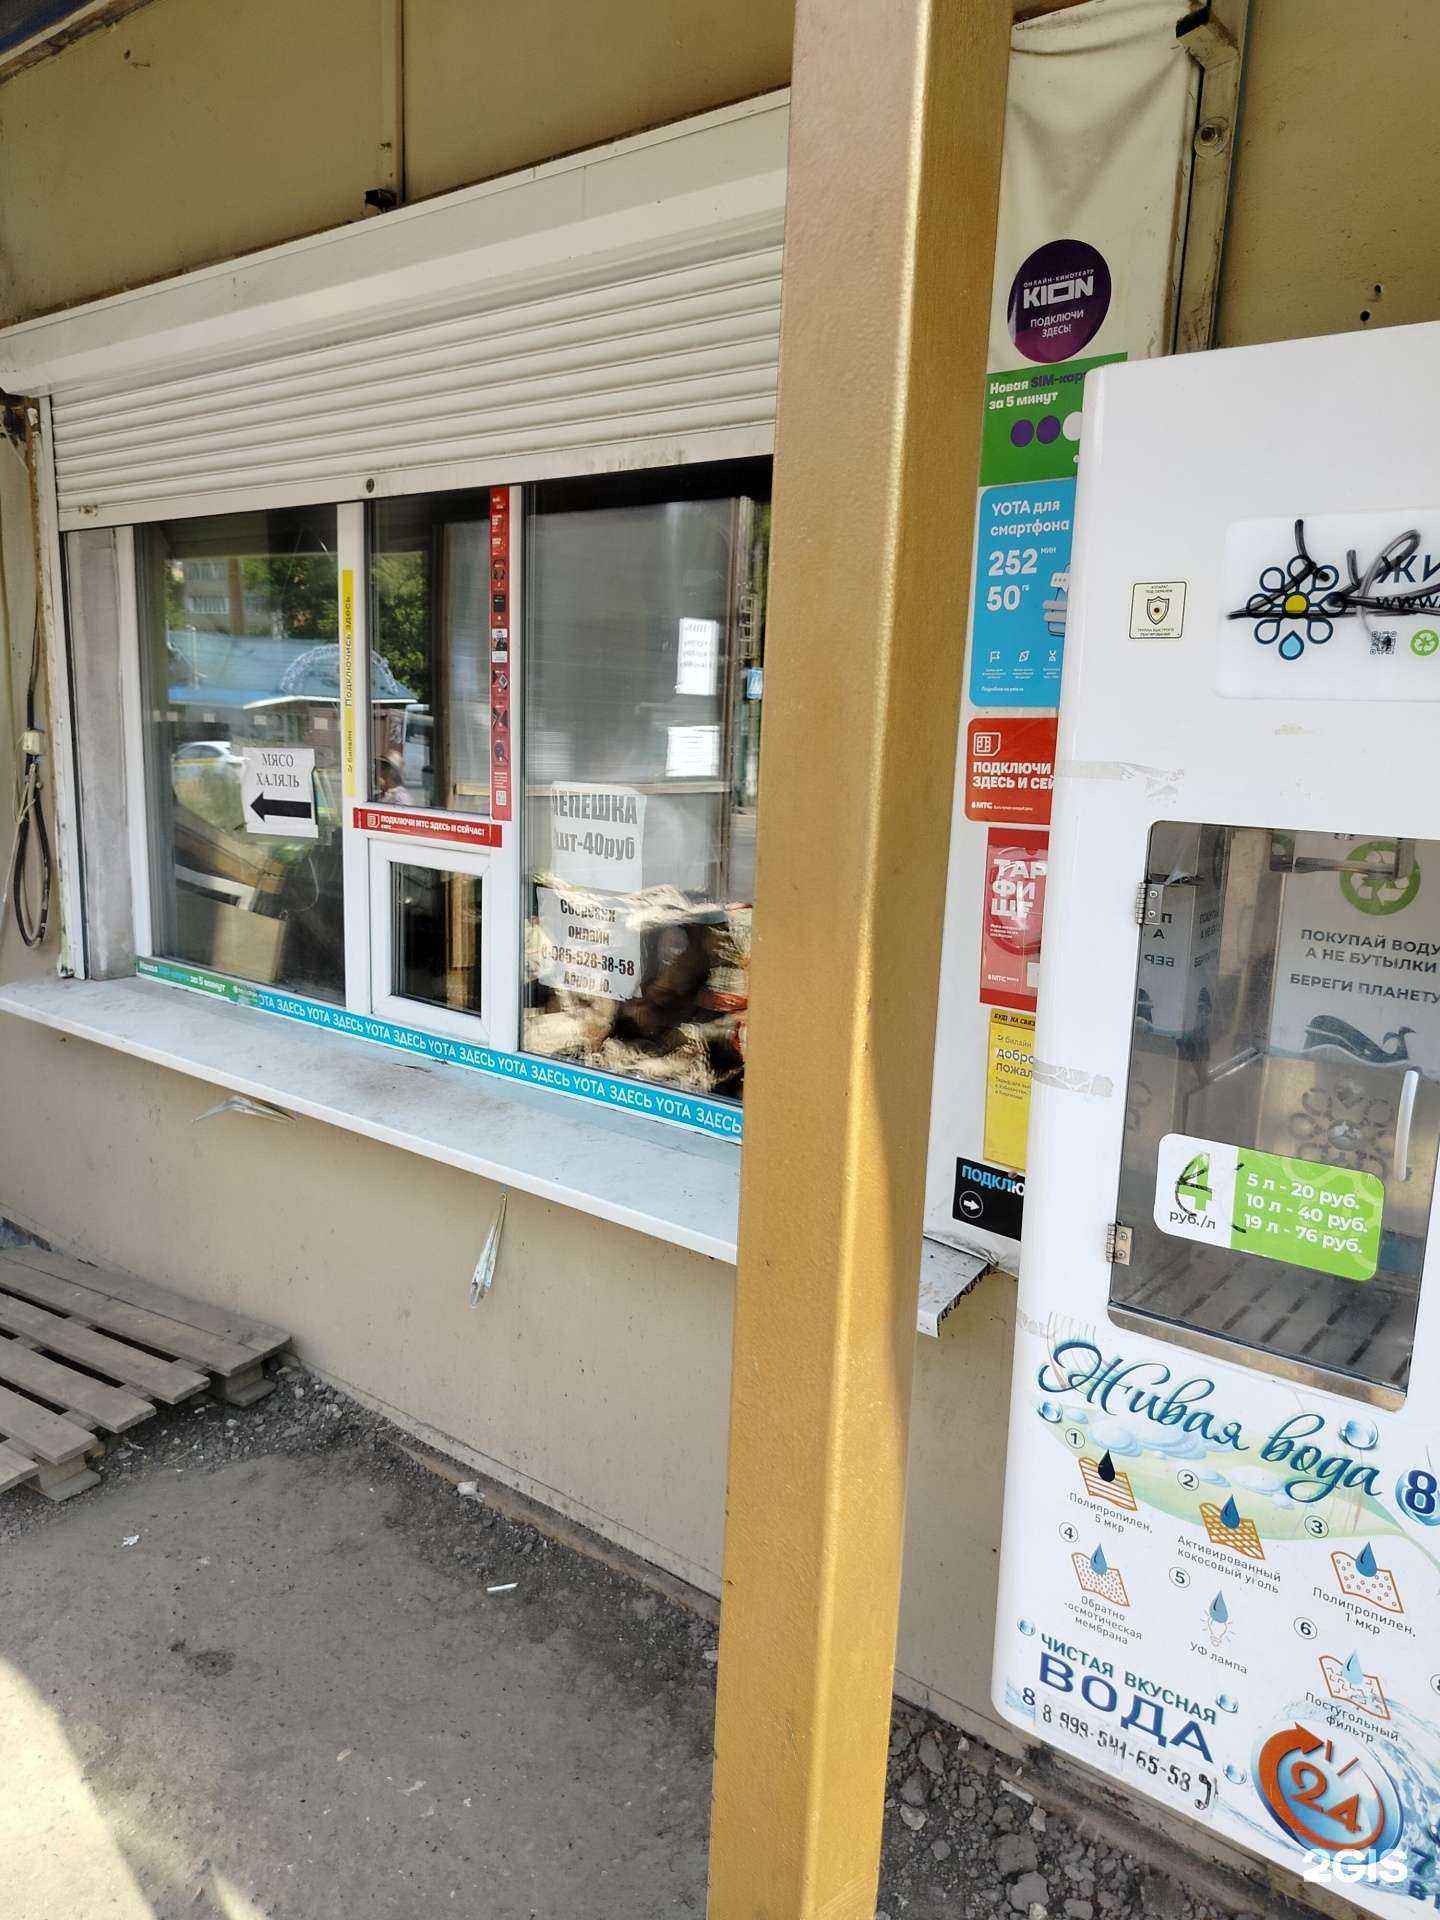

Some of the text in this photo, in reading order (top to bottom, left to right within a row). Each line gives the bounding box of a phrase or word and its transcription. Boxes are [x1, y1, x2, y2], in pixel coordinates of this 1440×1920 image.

[1023, 276, 1094, 309] KION
[1030, 309, 1084, 328] ПОДКЛЮЧИ
[1041, 324, 1072, 338] ЗДЕСЬ!
[990, 379, 1029, 394] Новая
[988, 391, 1058, 410] за 5 минут
[992, 500, 1060, 516] YOTA для
[991, 519, 1070, 538] смартфона
[988, 548, 1038, 577] 252
[986, 585, 1021, 612] 50
[262, 752, 294, 767] МЯСО
[973, 761, 1051, 775] ПОДКЛЮЧИ
[256, 772, 301, 788] ХАЛЯЛЬ
[973, 776, 1016, 789] ЗДЕСЬ
[1018, 777, 1028, 789] И
[381, 814, 415, 828] ПОДКЛЮЧИ
[1301, 929, 1386, 949] ПОКУПАЙ
[1305, 949, 1437, 973] А НЕ БУТЫЛКИ
[1290, 972, 1353, 992] БЕРЕГИ
[277, 998, 306, 1018] ЗДЕСЬ
[307, 1006, 331, 1024] YOTA
[333, 1013, 363, 1032] ЗДЕСЬ
[364, 1022, 391, 1040] YOTA
[394, 1030, 426, 1049] ЗДЕСЬ
[428, 1039, 456, 1057] YOTA
[459, 1047, 496, 1068] ЗДЕСЬ
[498, 1057, 527, 1077] YOTA
[531, 1065, 570, 1087] ЗДЕСЬ
[572, 1075, 606, 1097] YOTA
[610, 1085, 653, 1108] ЗДЕСЬ
[655, 1096, 691, 1120] YOTA
[696, 1107, 742, 1134] ЗДЕСЬ
[1246, 1172, 1258, 1187] 5
[1262, 1179, 1275, 1192] л
[1291, 1182, 1315, 1200] 20
[1319, 1190, 1361, 1210] руб.
[1169, 1210, 1216, 1230] руб./л
[1245, 1192, 1264, 1209] 10
[1268, 1200, 1281, 1213] л
[1298, 1205, 1323, 1223] 40
[1327, 1212, 1368, 1234] руб.
[1243, 1213, 1262, 1231] 19
[1266, 1221, 1280, 1234] л
[1295, 1225, 1319, 1244] 76
[1322, 1232, 1363, 1254] руб.
[1038, 1341, 1250, 1451] Живая
[1095, 1513, 1125, 1534] 5 мкр
[1177, 1535, 1281, 1582] Активированный
[1177, 1548, 1279, 1594] кокосовый уголь
[1081, 1595, 1125, 1621] Обратно
[1075, 1616, 1129, 1645] мембрана
[1344, 1612, 1381, 1636] 1 мкр
[1191, 1642, 1249, 1676] УФ лампа
[1041, 1633, 1217, 1726] ЧИСТАЯ ВКУСНАЯ
[1039, 1652, 1214, 1763] ВОДА
[1042, 1703, 1052, 1724] 8
[1306, 1692, 1399, 1741] Постугольный
[1326, 1714, 1374, 1743] фильтр
[1290, 1761, 1362, 1833] 24
